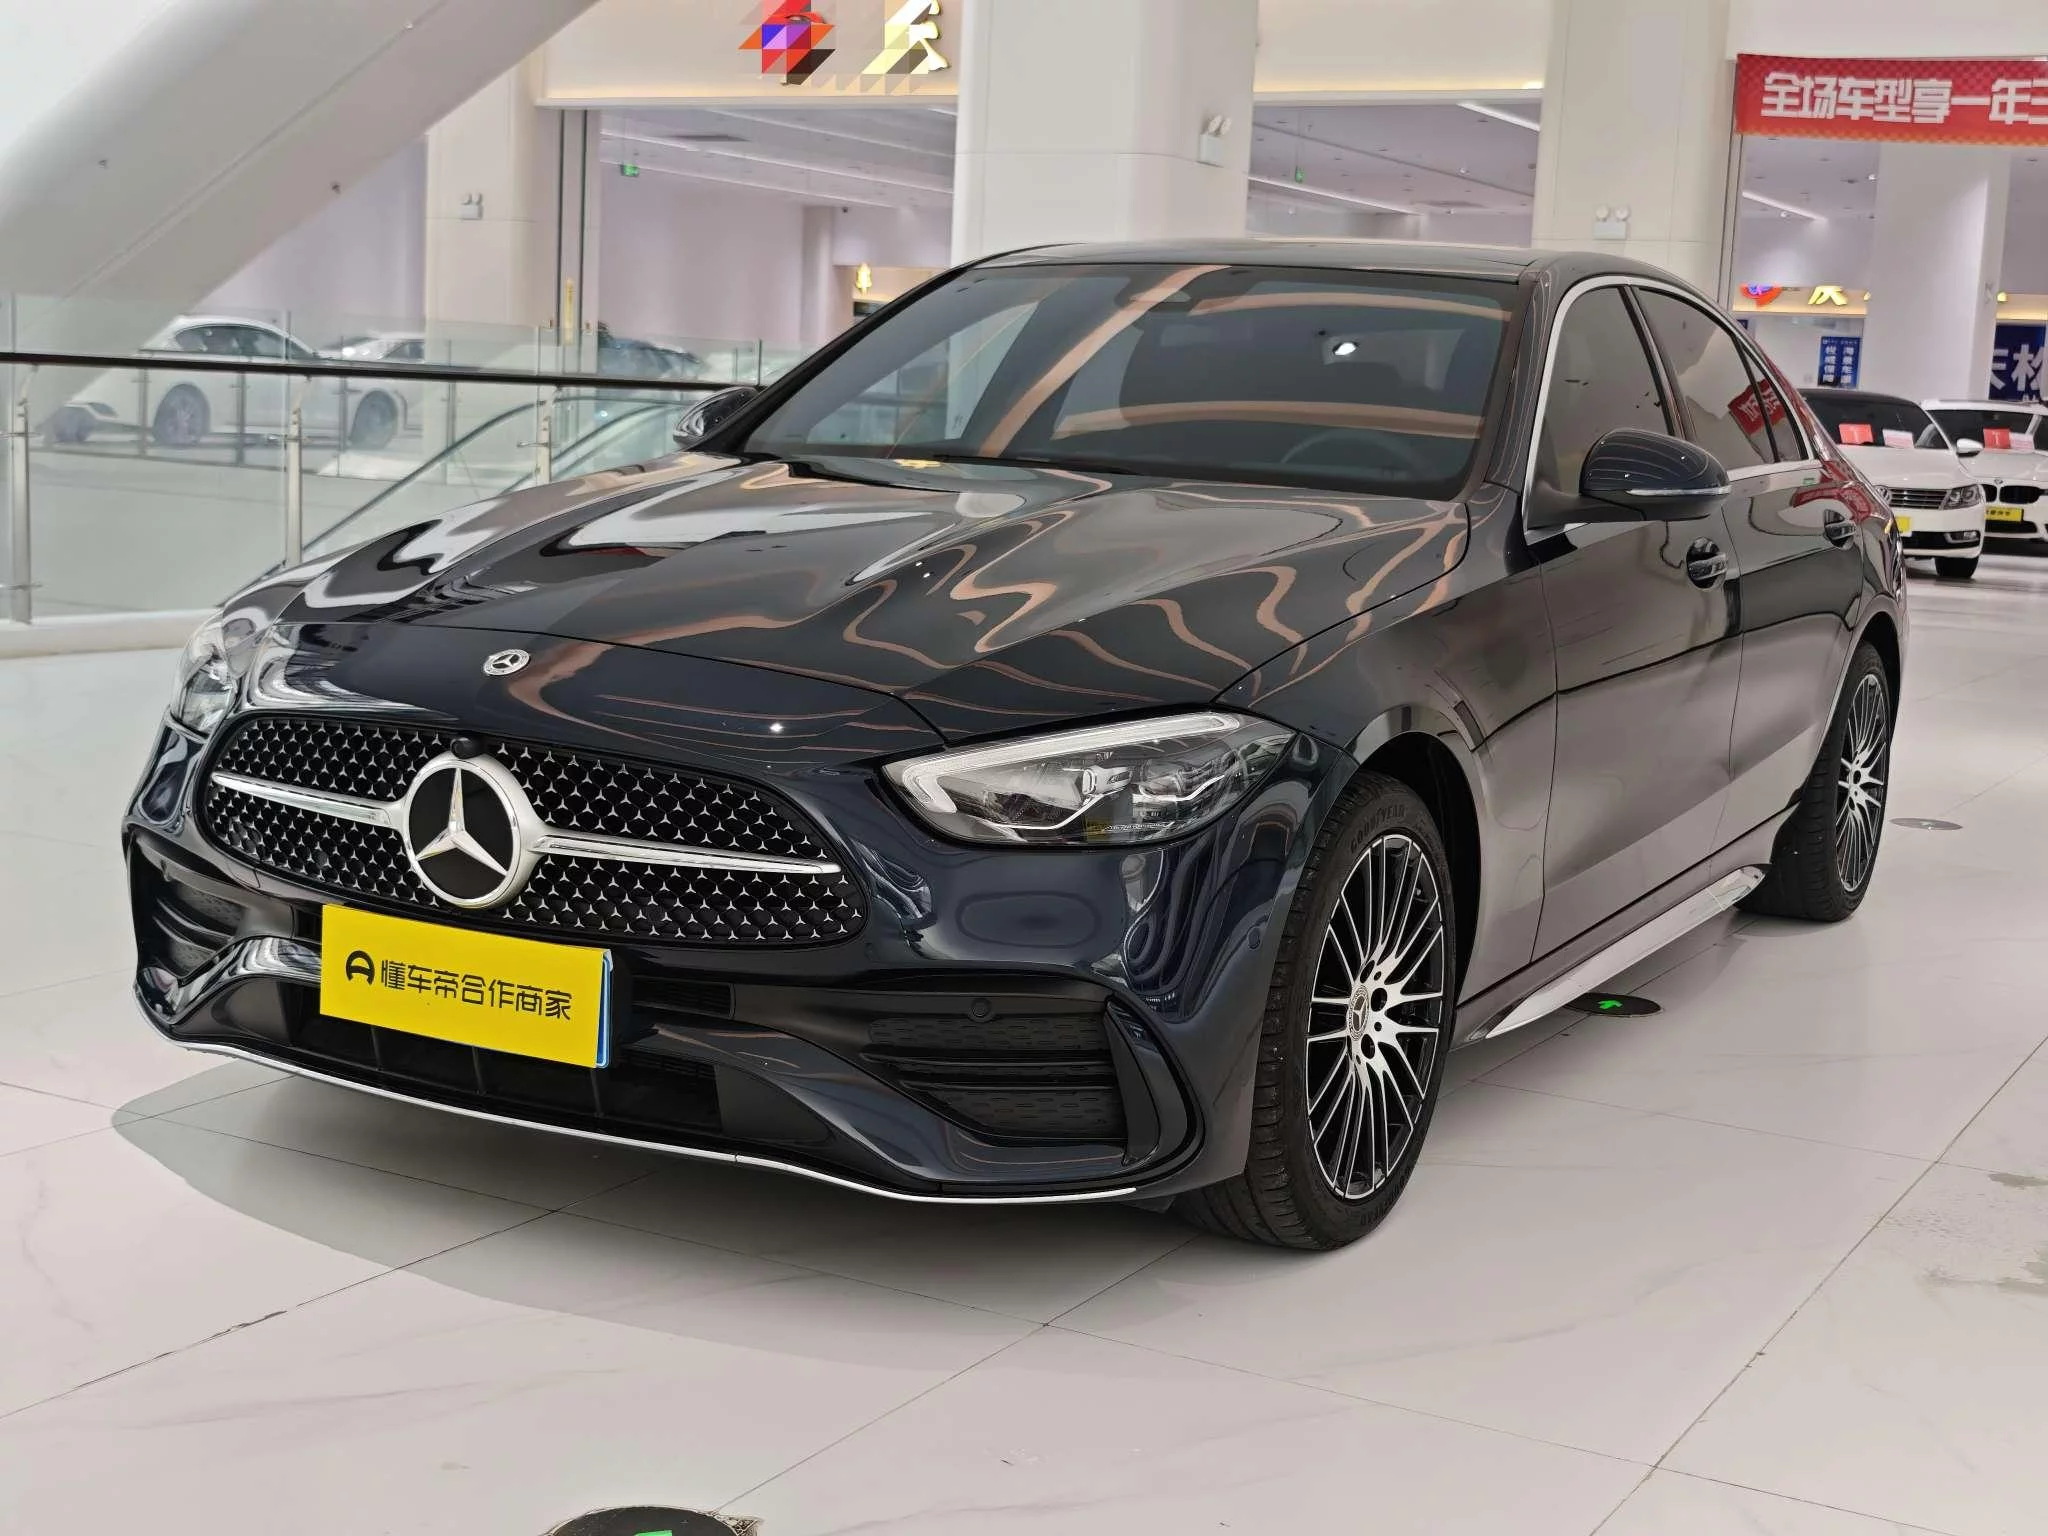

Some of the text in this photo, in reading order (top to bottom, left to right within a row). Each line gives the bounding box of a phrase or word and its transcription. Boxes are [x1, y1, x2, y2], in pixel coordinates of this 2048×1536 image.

[381, 959, 573, 1021] 懂车帝合作商家
